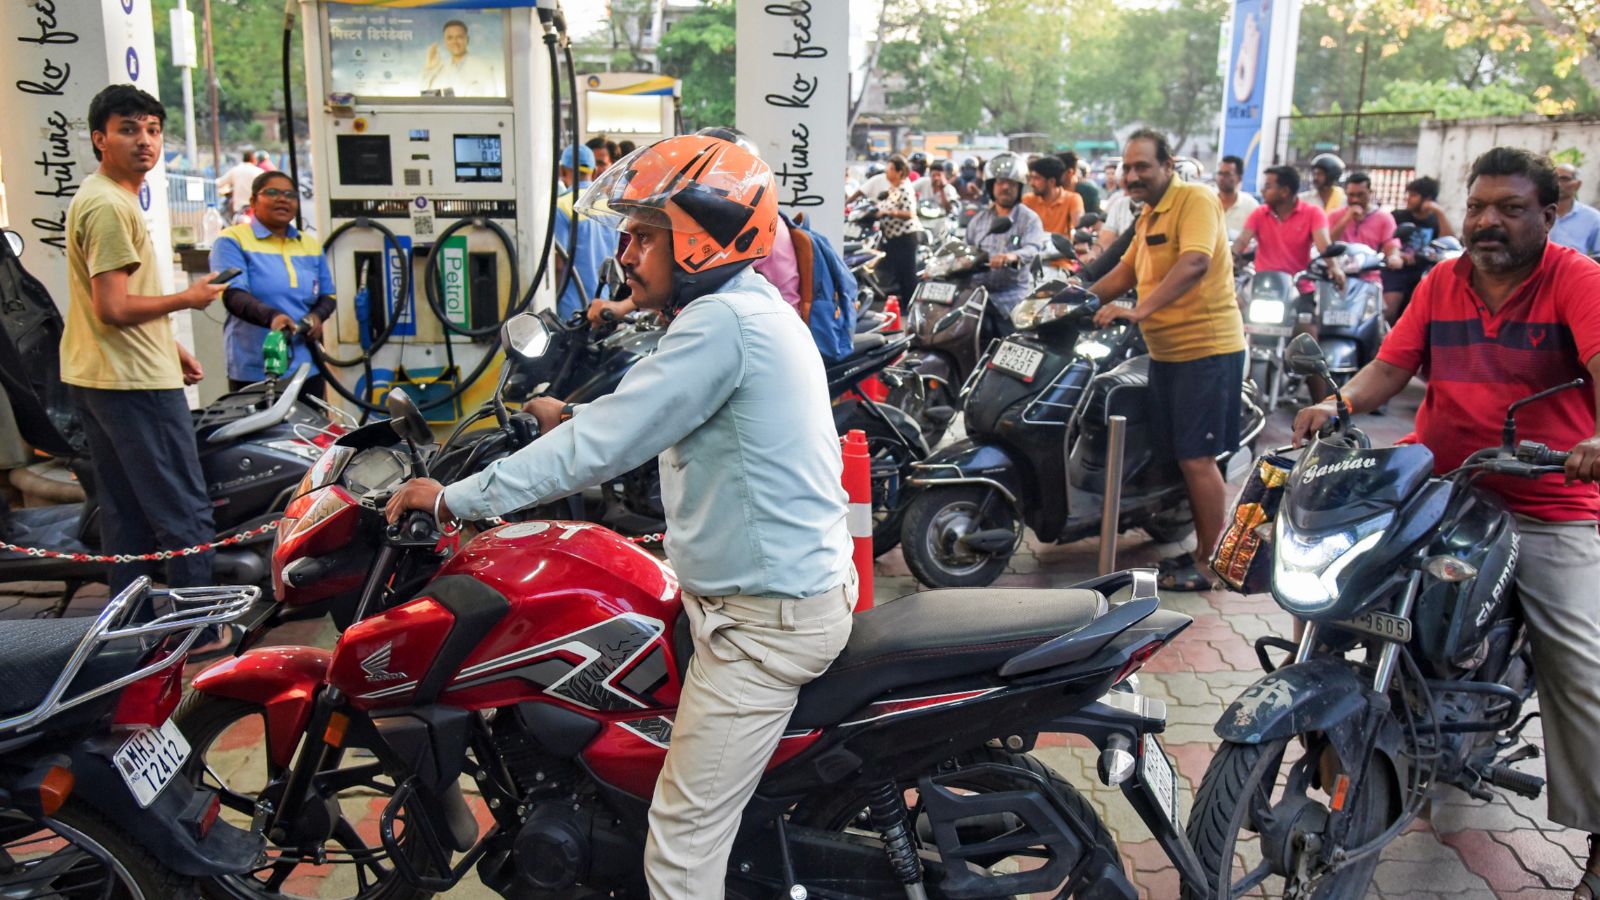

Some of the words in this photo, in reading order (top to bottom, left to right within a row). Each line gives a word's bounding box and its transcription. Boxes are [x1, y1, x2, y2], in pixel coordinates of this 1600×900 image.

[764, 0, 828, 59] feel
[16, 59, 70, 95] ko
[765, 73, 818, 108] ko
[34, 111, 80, 198] future
[774, 123, 825, 208] future
[390, 255, 410, 317] Diesl
[445, 256, 463, 315] Petrol
[1303, 457, 1376, 484] Gaurav
[141, 740, 184, 792] T2412
